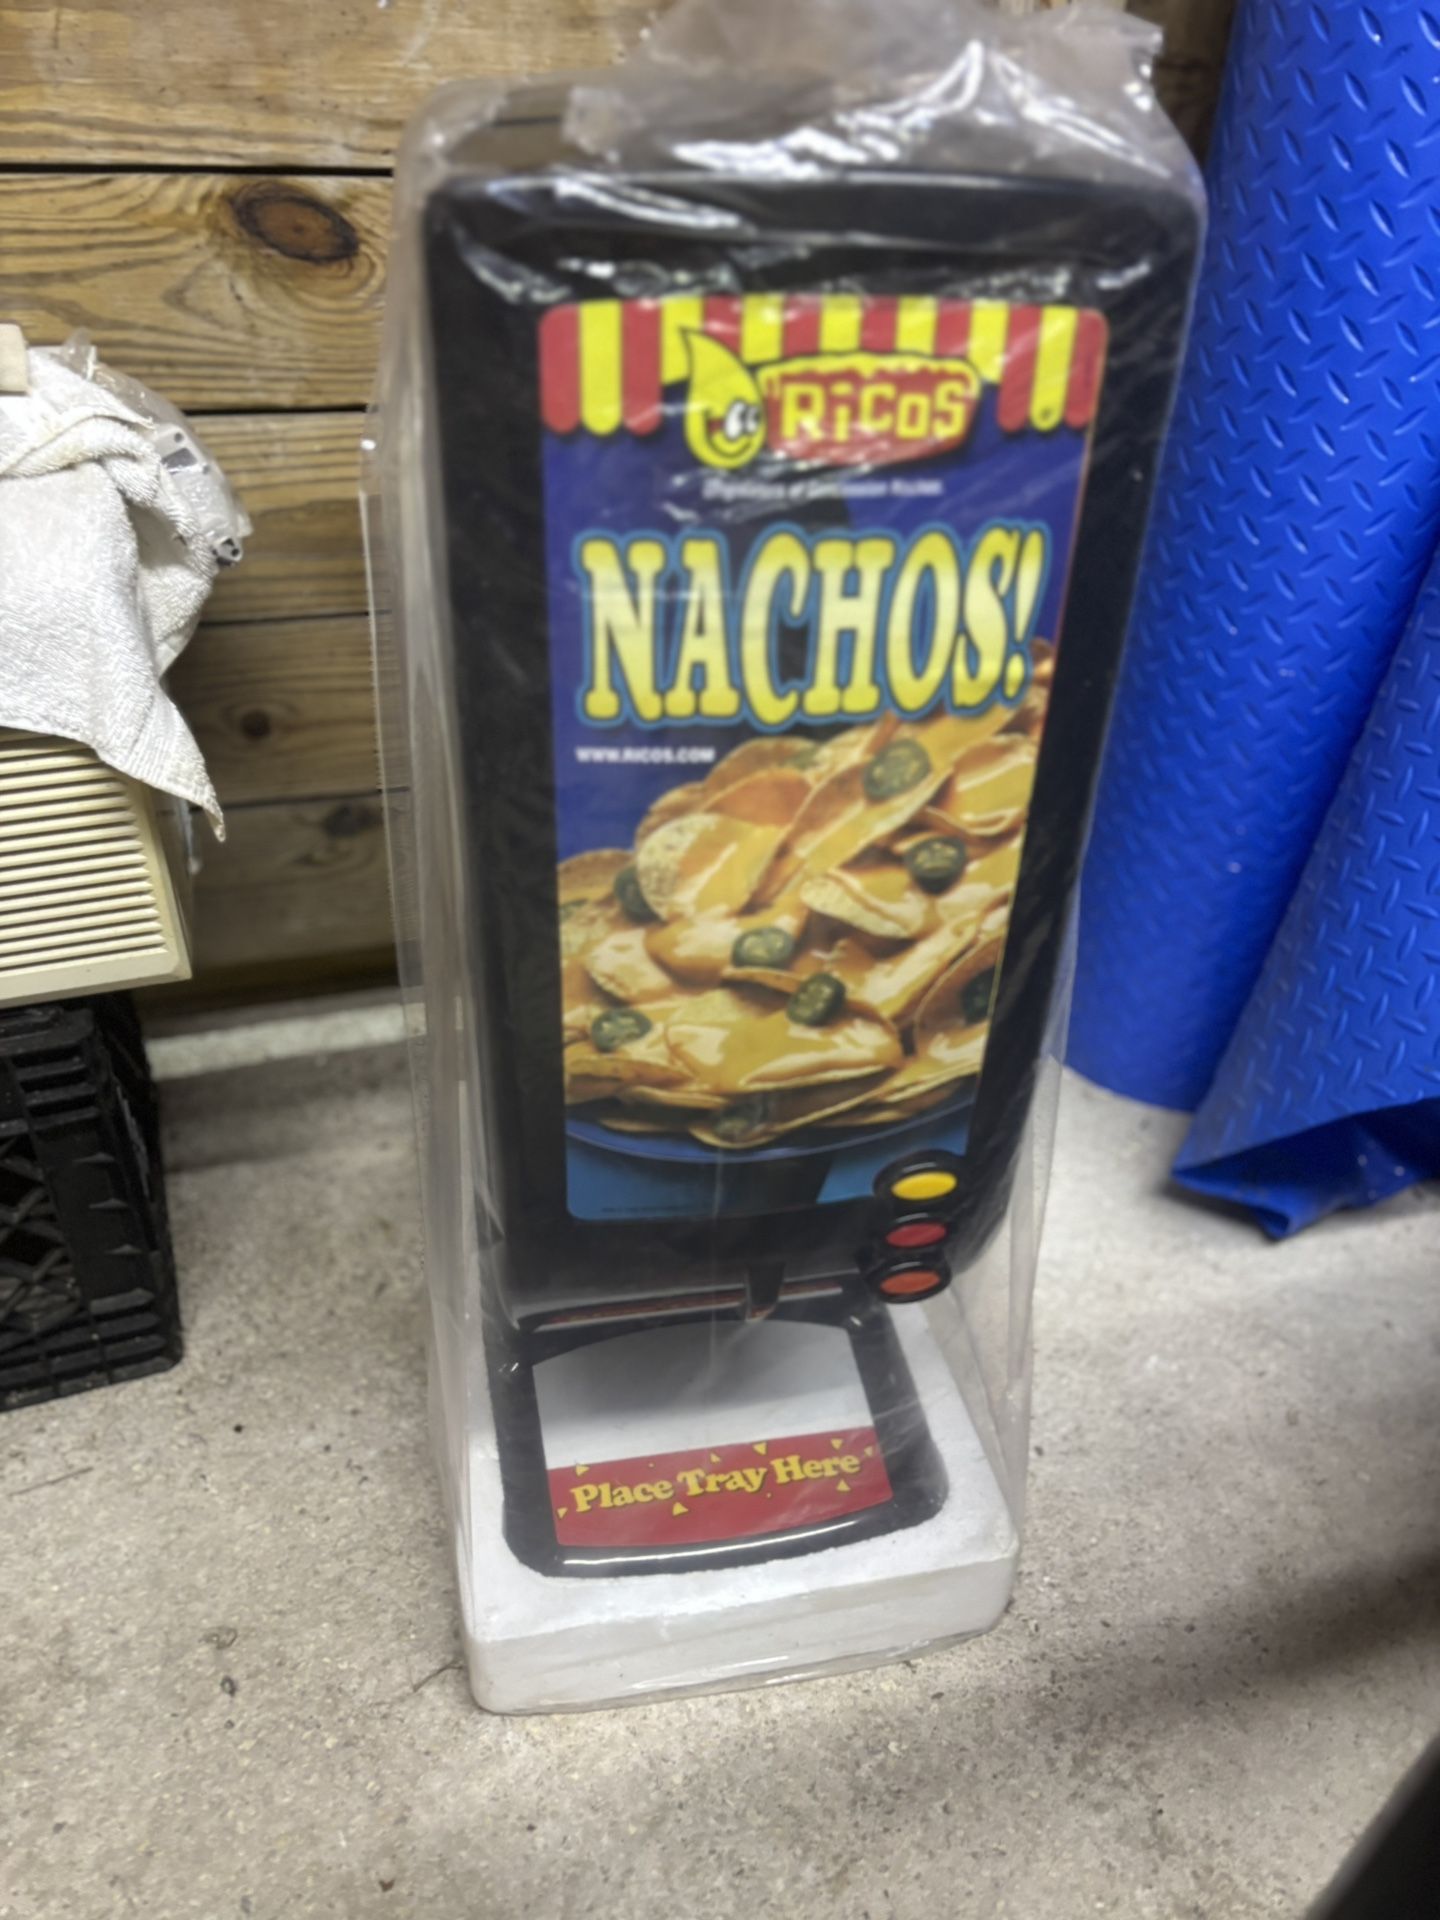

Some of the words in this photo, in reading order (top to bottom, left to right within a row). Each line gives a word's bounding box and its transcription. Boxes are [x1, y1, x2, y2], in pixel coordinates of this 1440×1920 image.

[576, 523, 1048, 729] NACHOS!
[575, 746, 716, 764] WWW.RICOS.COM
[570, 1477, 675, 1512] Place
[677, 1466, 768, 1498] Tray
[770, 1454, 861, 1485] Here
